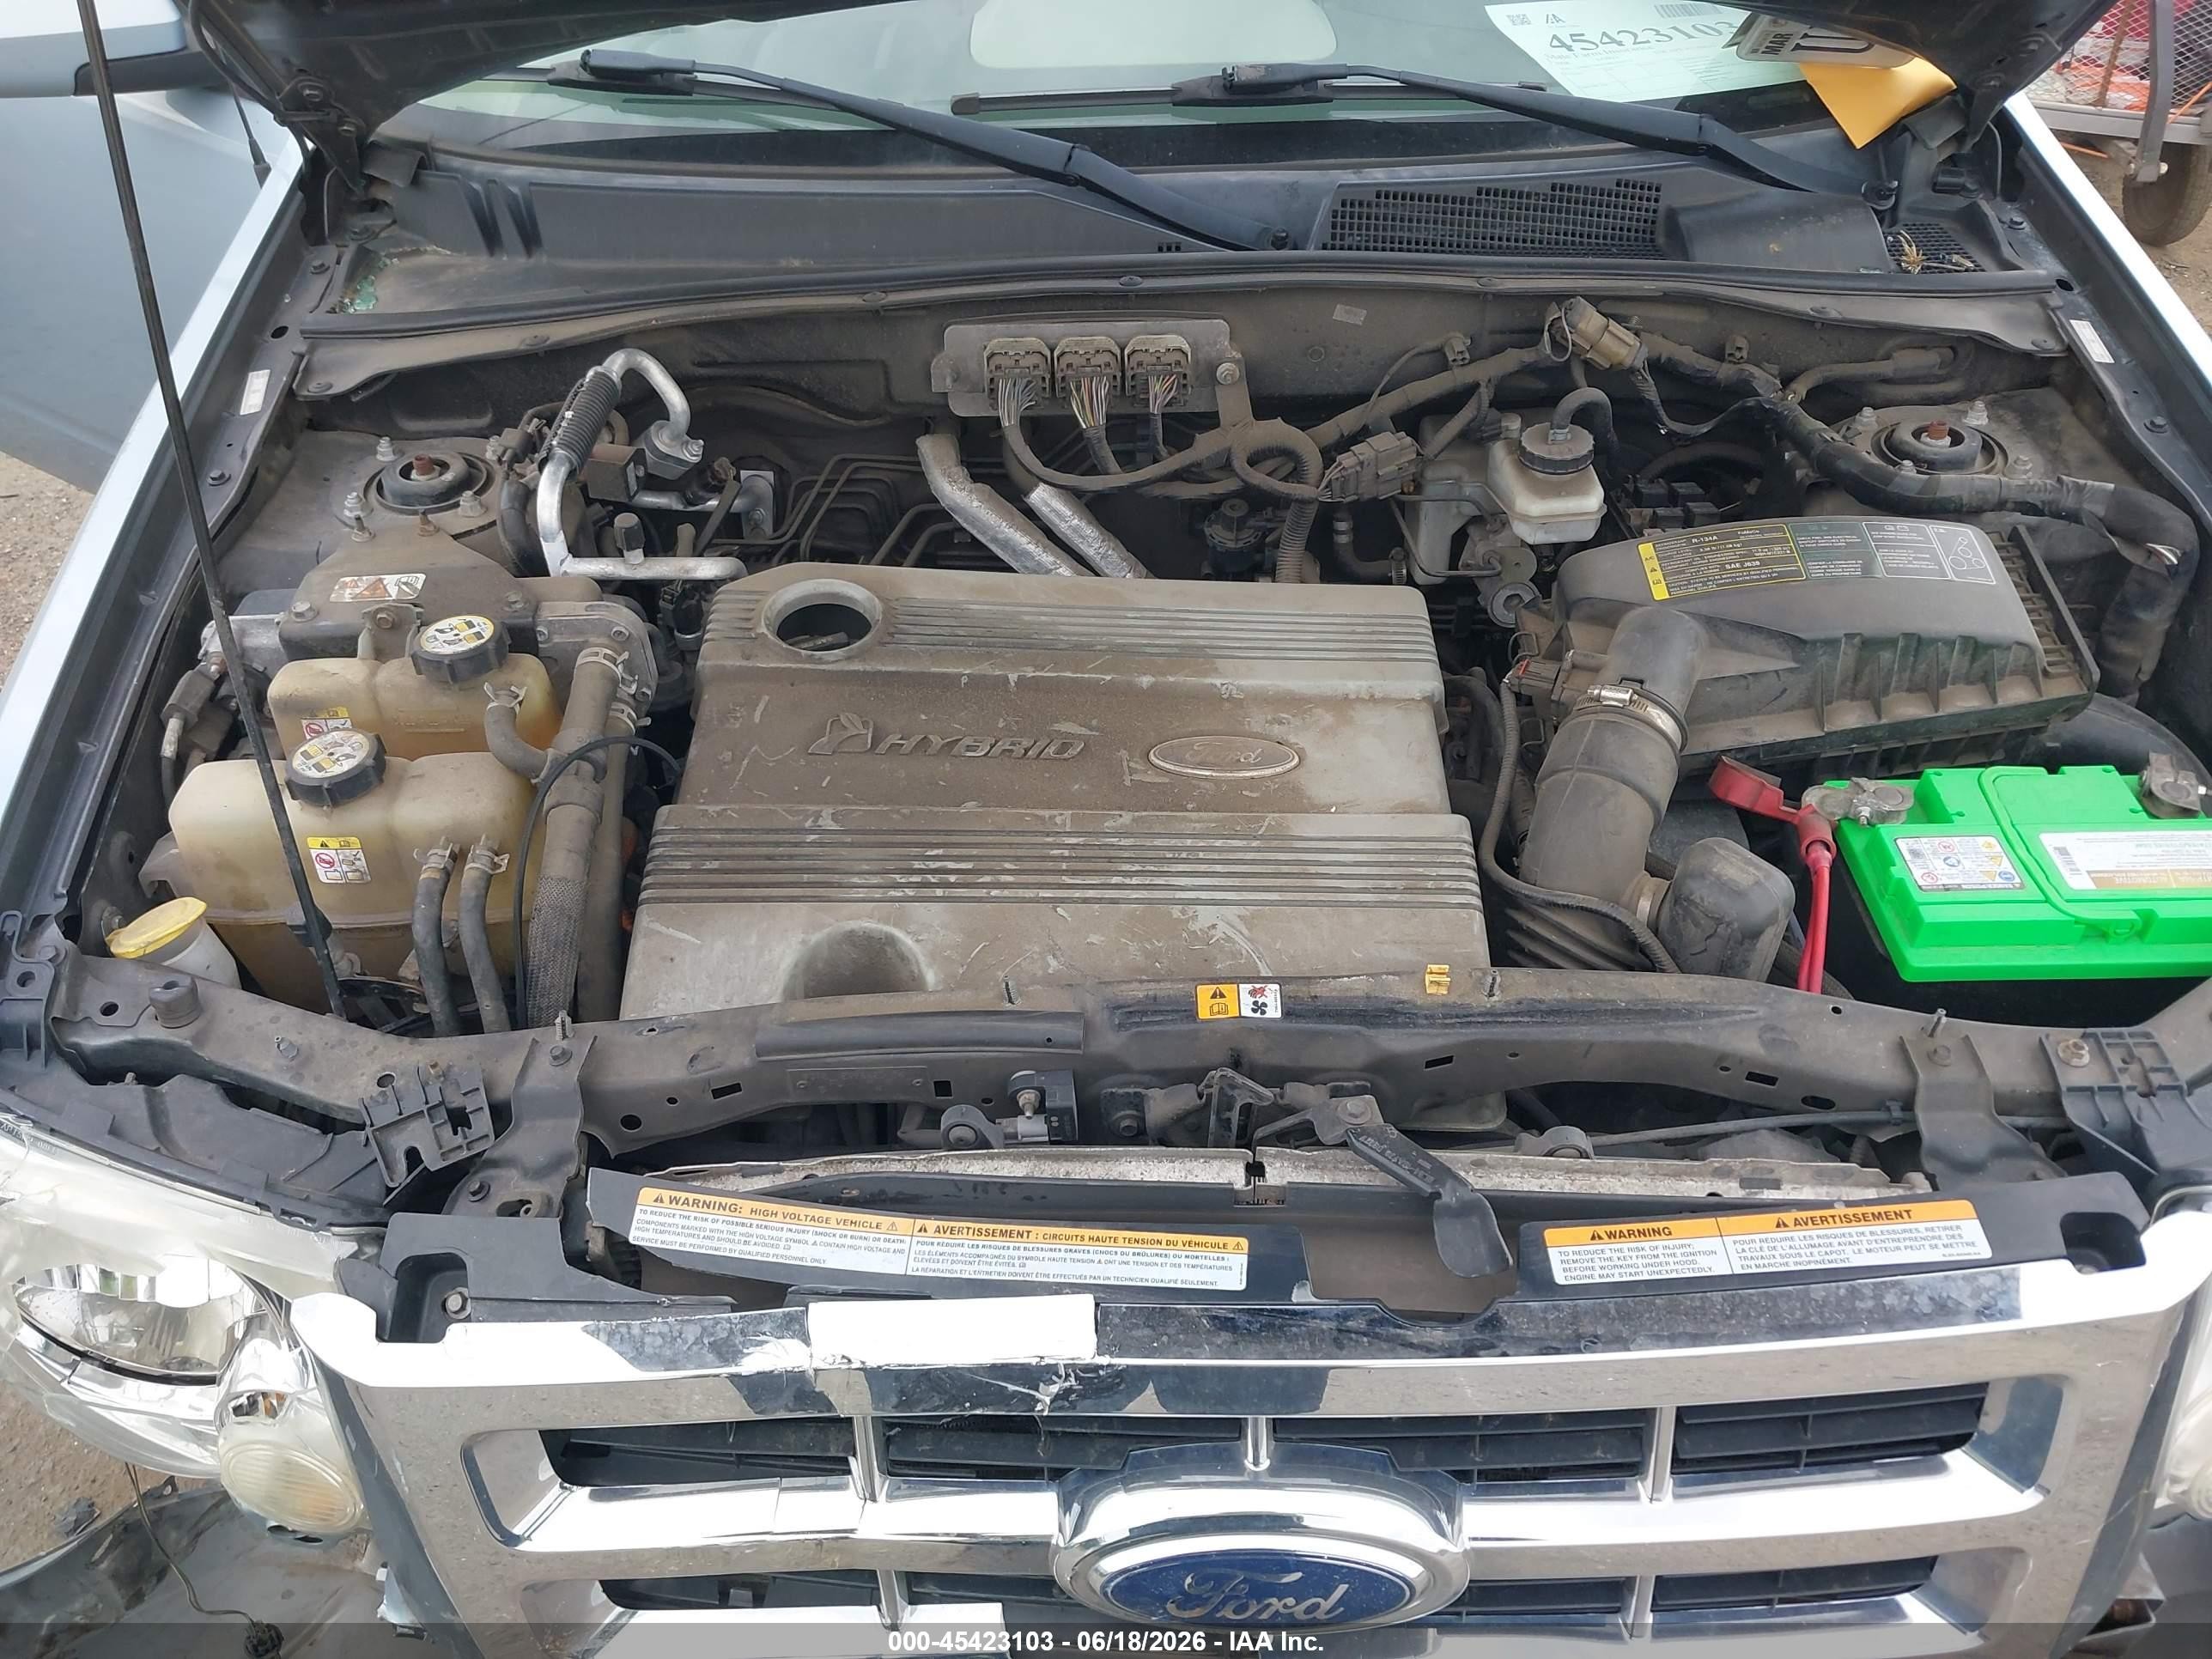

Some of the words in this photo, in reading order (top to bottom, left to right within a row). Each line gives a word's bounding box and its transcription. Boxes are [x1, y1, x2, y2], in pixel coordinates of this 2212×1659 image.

[1761, 33, 1793, 55] MAR
[874, 734, 1086, 760] HYBRID
[668, 1194, 743, 1213] WARNING:
[750, 1207, 778, 1218] HIGH
[781, 1211, 832, 1224] VOLTAGE
[835, 1218, 883, 1230] VEHICLE
[1791, 1209, 1914, 1227] AVERTISSEMENT
[933, 1224, 1032, 1239] AVERTISSEMENT
[1042, 1232, 1085, 1242] CIRCUITS
[1087, 1235, 1119, 1243] HAUTE
[1122, 1237, 1163, 1245] TENSION
[1181, 1239, 1229, 1249] VÉHICULE
[1604, 1226, 1673, 1239] WARNING
[1166, 1569, 1349, 1620] Ford
